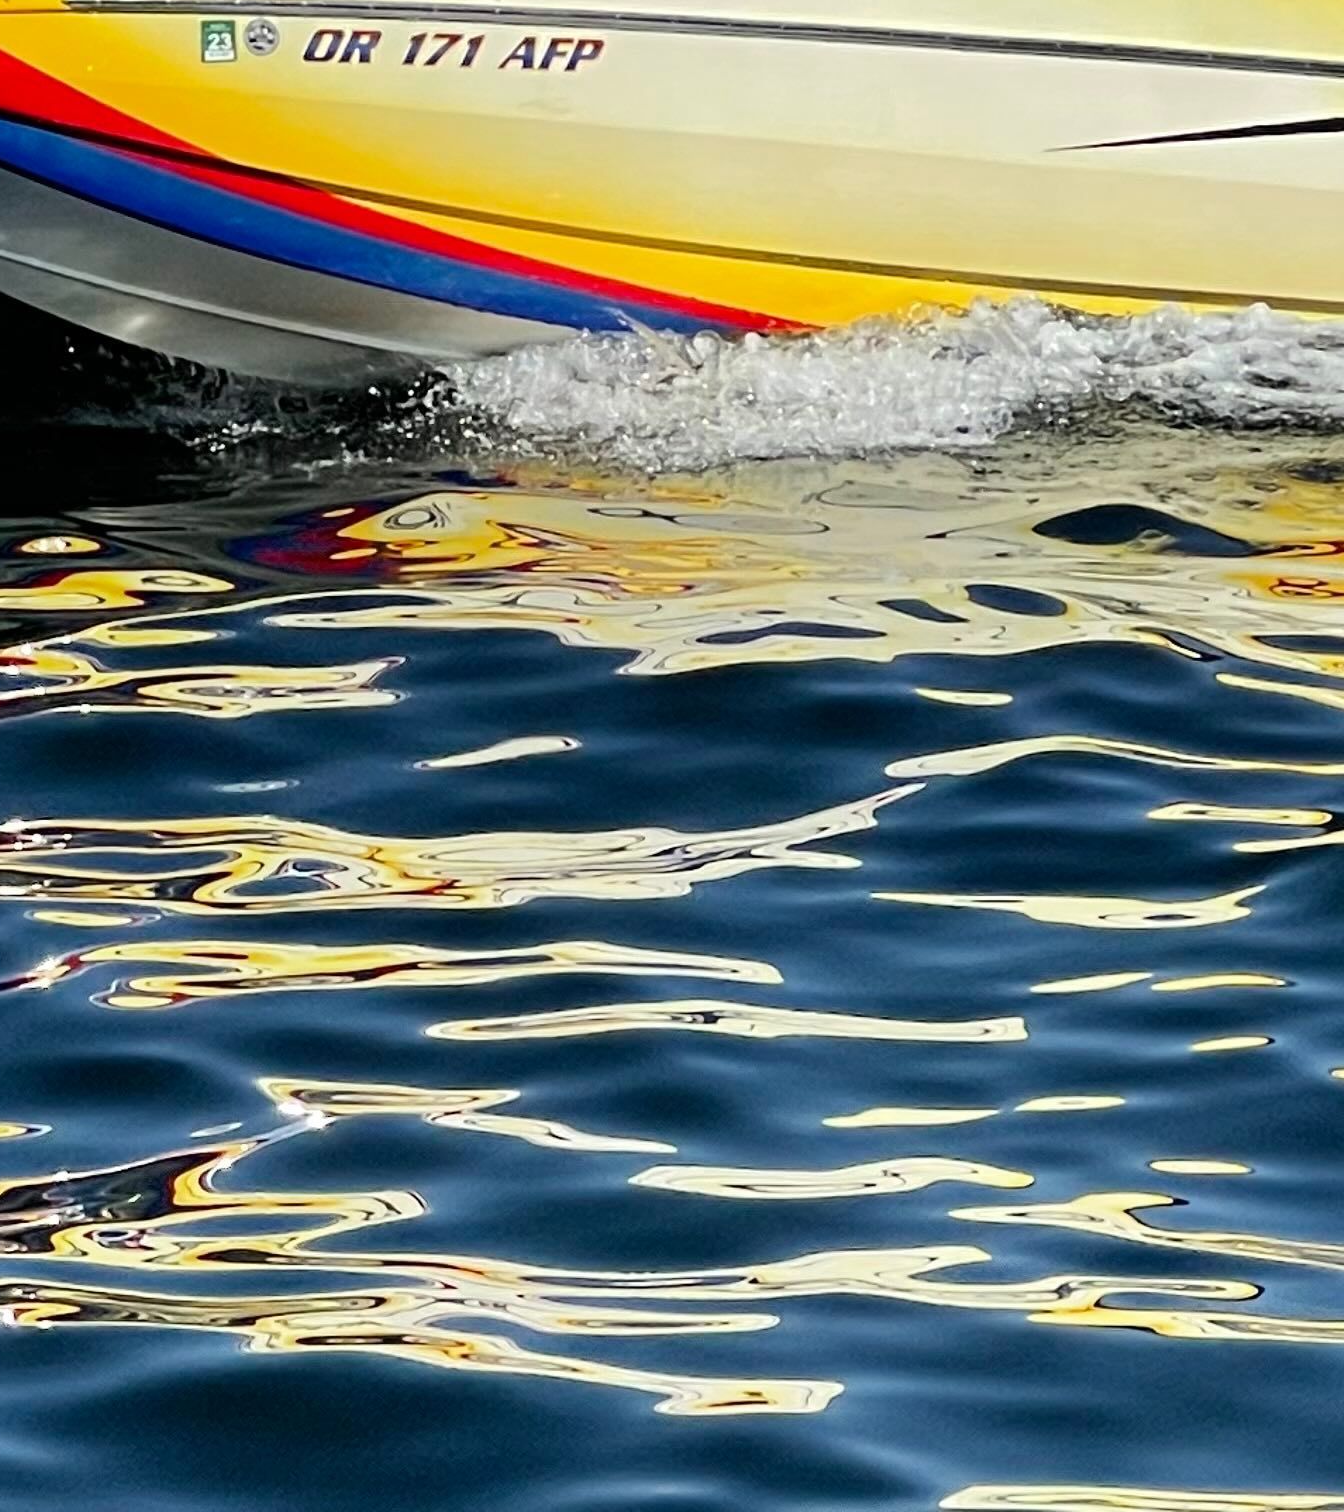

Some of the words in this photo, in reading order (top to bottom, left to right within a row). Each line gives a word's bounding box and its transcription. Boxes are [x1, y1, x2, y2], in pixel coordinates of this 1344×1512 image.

[208, 33, 232, 51] 23
[303, 29, 382, 63] OR
[403, 33, 485, 67] 171
[498, 37, 605, 71] AFP
